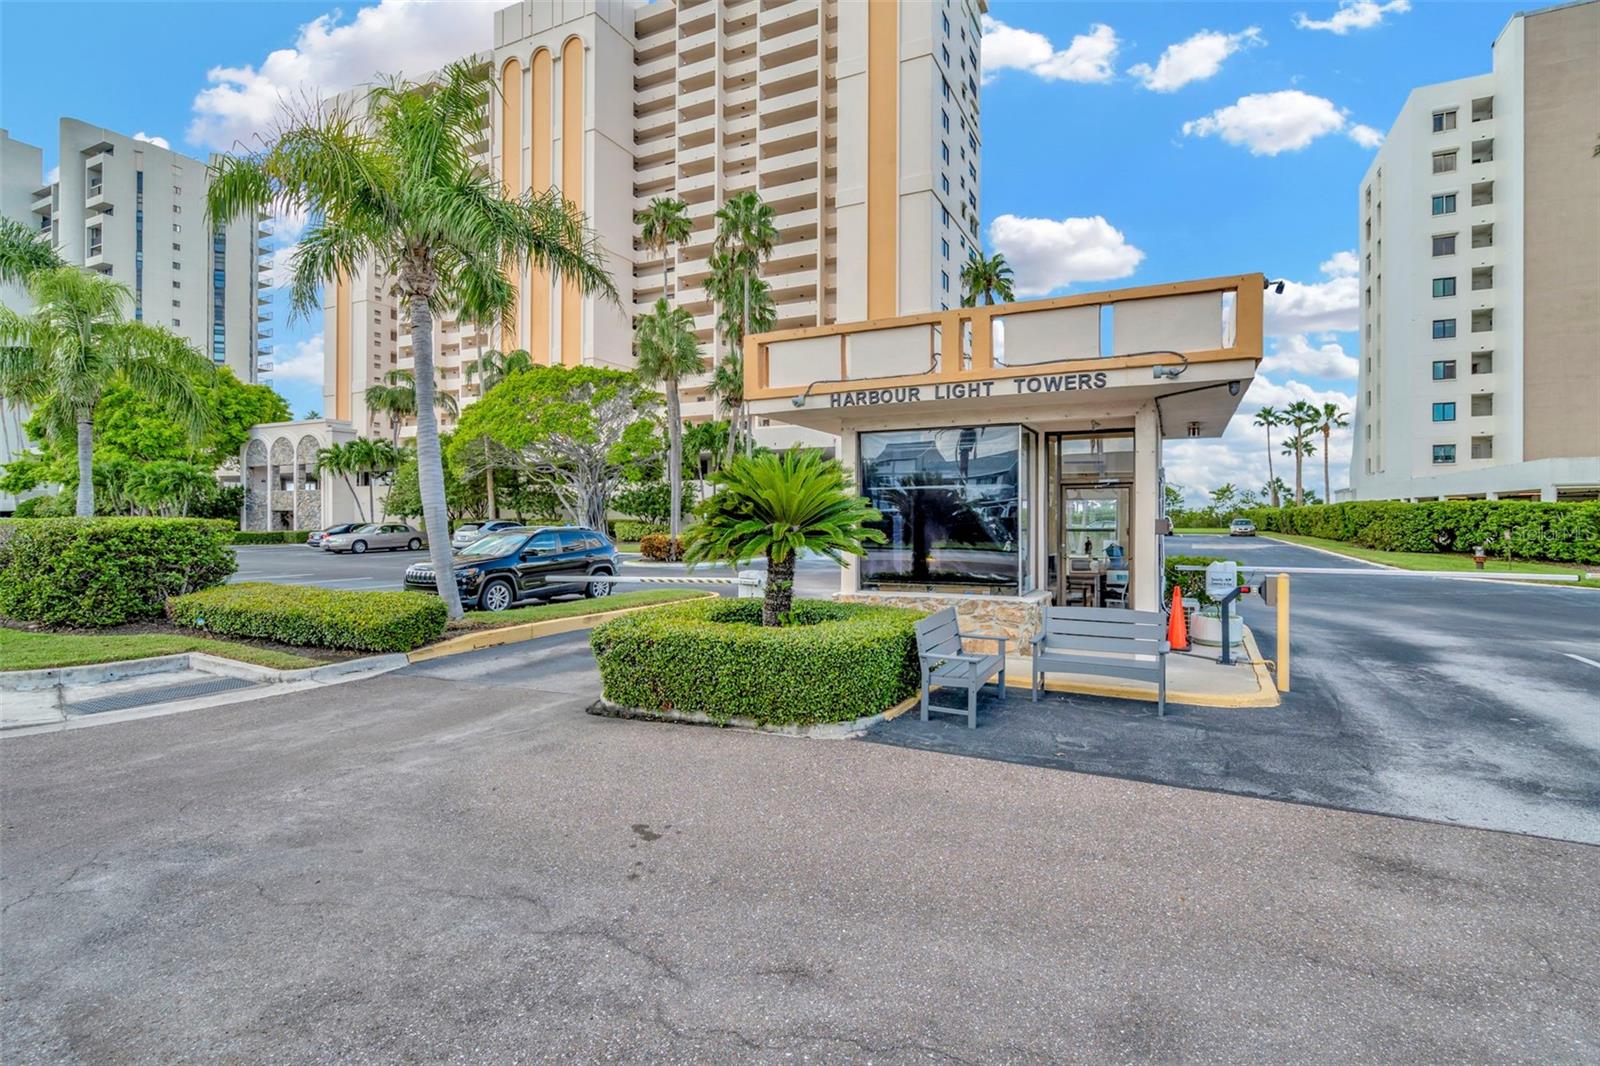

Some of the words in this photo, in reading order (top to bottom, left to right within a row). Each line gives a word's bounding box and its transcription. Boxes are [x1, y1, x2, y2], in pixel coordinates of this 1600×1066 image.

[830, 387, 921, 408] HARBOUR
[935, 381, 994, 400] LIGHT
[1013, 372, 1107, 394] TOWERS
